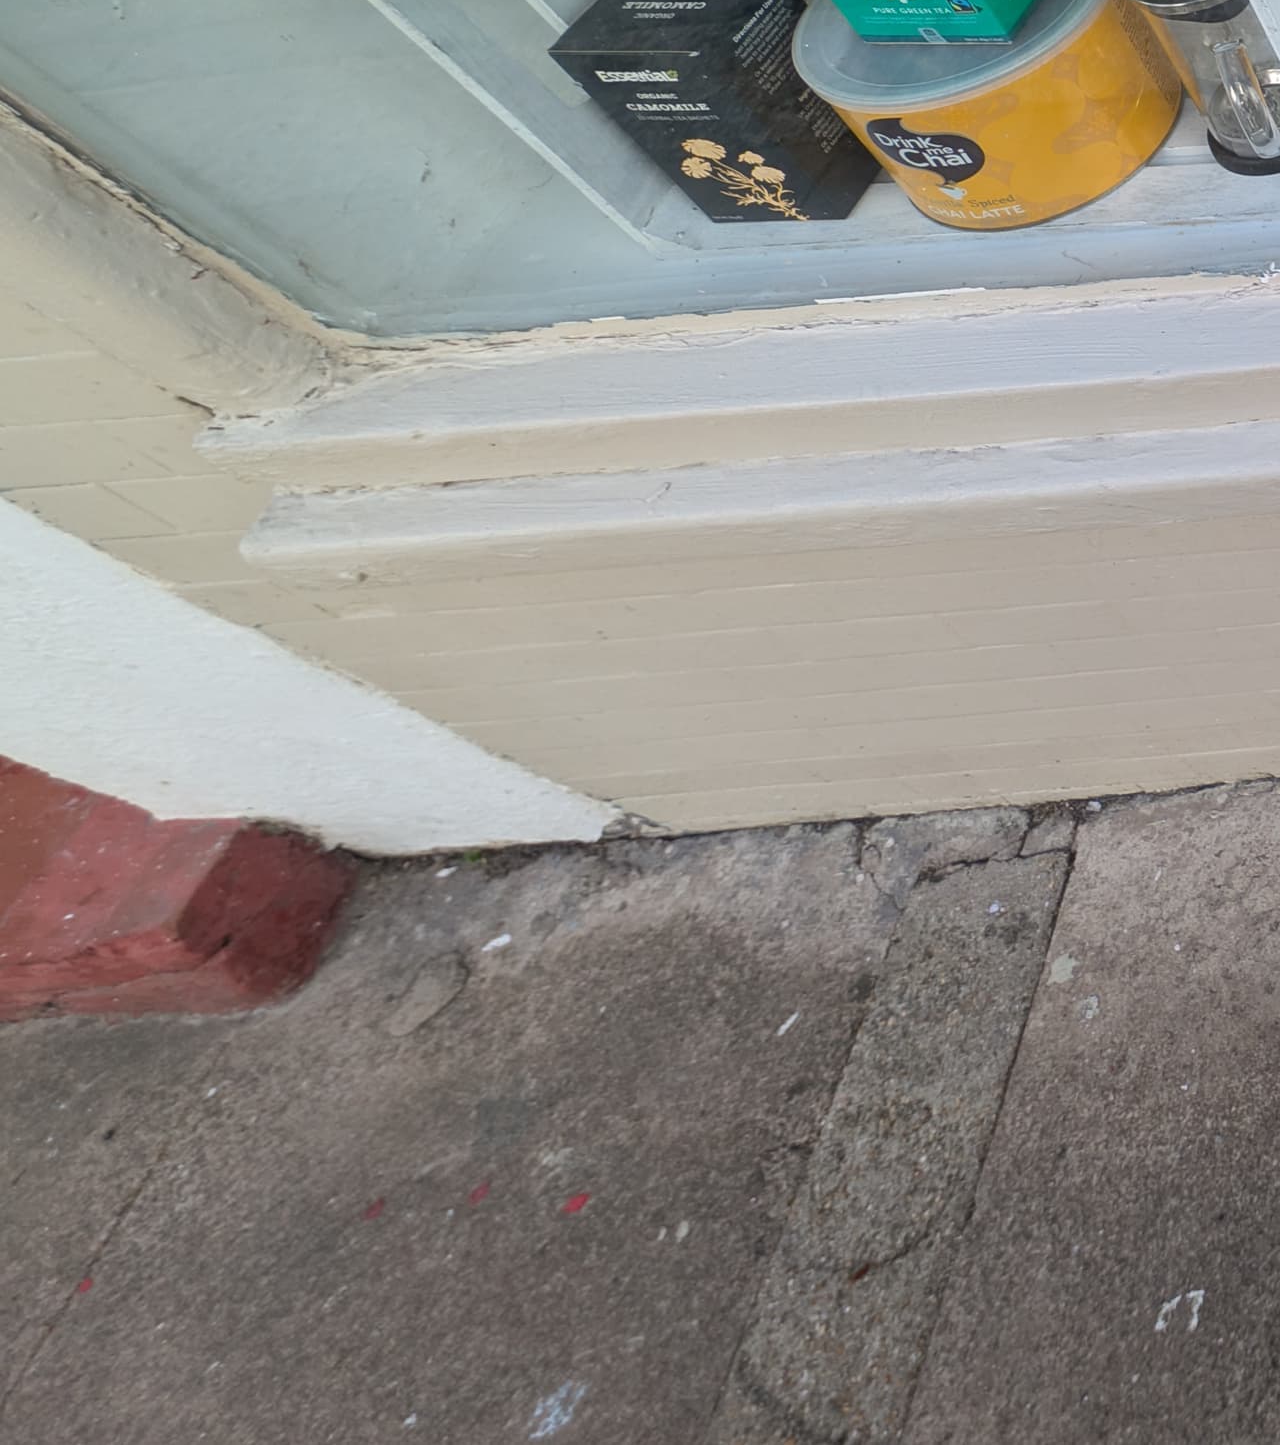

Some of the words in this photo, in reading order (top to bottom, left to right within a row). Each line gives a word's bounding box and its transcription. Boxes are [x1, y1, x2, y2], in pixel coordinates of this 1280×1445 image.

[622, 1, 707, 10] CAMOMILE
[872, 6, 897, 14] PURE
[900, 7, 932, 15] GREEN
[934, 7, 951, 15] TEA
[625, 103, 711, 112] CAMOMILE
[873, 132, 943, 149] Drink
[928, 146, 954, 156] me
[898, 148, 974, 168] Chai
[968, 194, 1016, 210] Spiced
[969, 204, 1025, 219] LATTE
